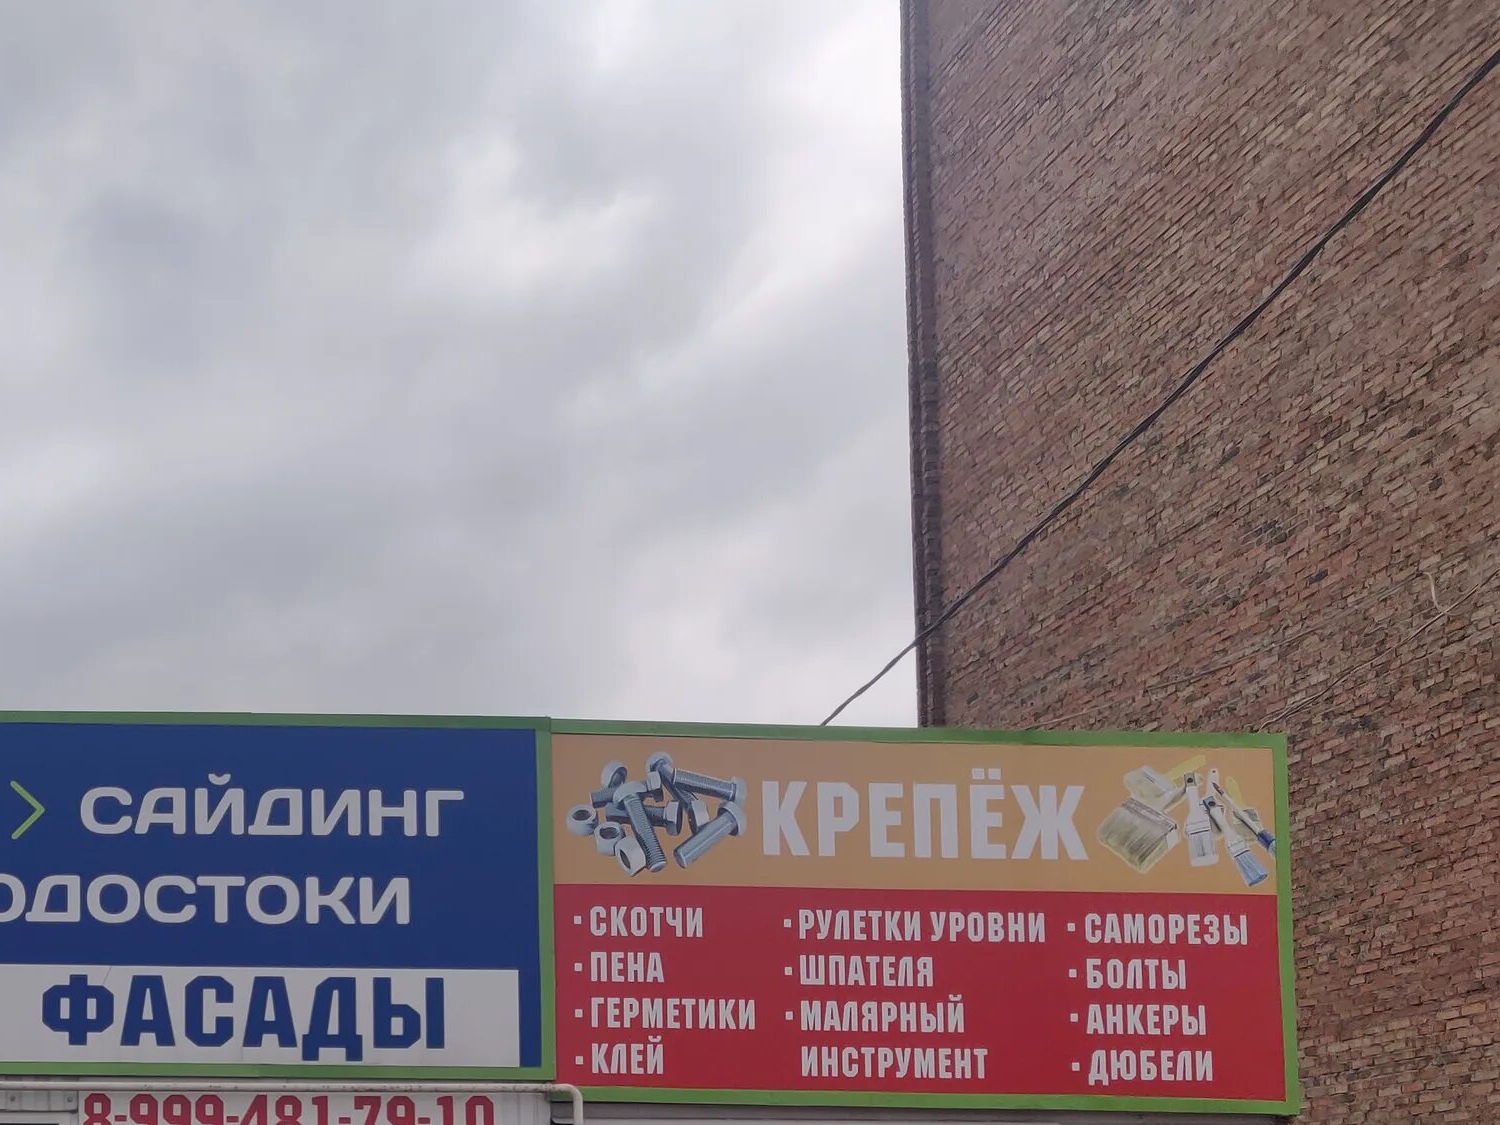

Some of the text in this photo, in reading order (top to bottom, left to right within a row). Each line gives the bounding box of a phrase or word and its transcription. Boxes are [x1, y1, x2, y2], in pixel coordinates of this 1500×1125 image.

[80, 773, 464, 836] САЙДИНГ
[762, 768, 1088, 861] КРЕПЁЖ
[589, 906, 703, 939] СКОТЧИ
[798, 909, 1046, 944] РУЛЕТКИ УРОВНИ
[1085, 913, 1248, 946] САМОРЕЗЫ
[590, 952, 665, 984] ПЕНА
[799, 955, 934, 988] ШПАТЕЛЯ
[1086, 959, 1187, 991] БОЛТЫ
[42, 973, 445, 1061] ФАСАДЫ
[590, 997, 756, 1031] ГЕРМЕТИКИ
[800, 994, 964, 1034] МАЛЯРНЫЙ
[1087, 1005, 1207, 1036] АНКЕРЫ
[591, 1036, 665, 1076] КЛЕЙ
[801, 1047, 988, 1080] ИНСТРУМЕНТ
[1089, 1049, 1213, 1085] ДЮБЕЛИ
